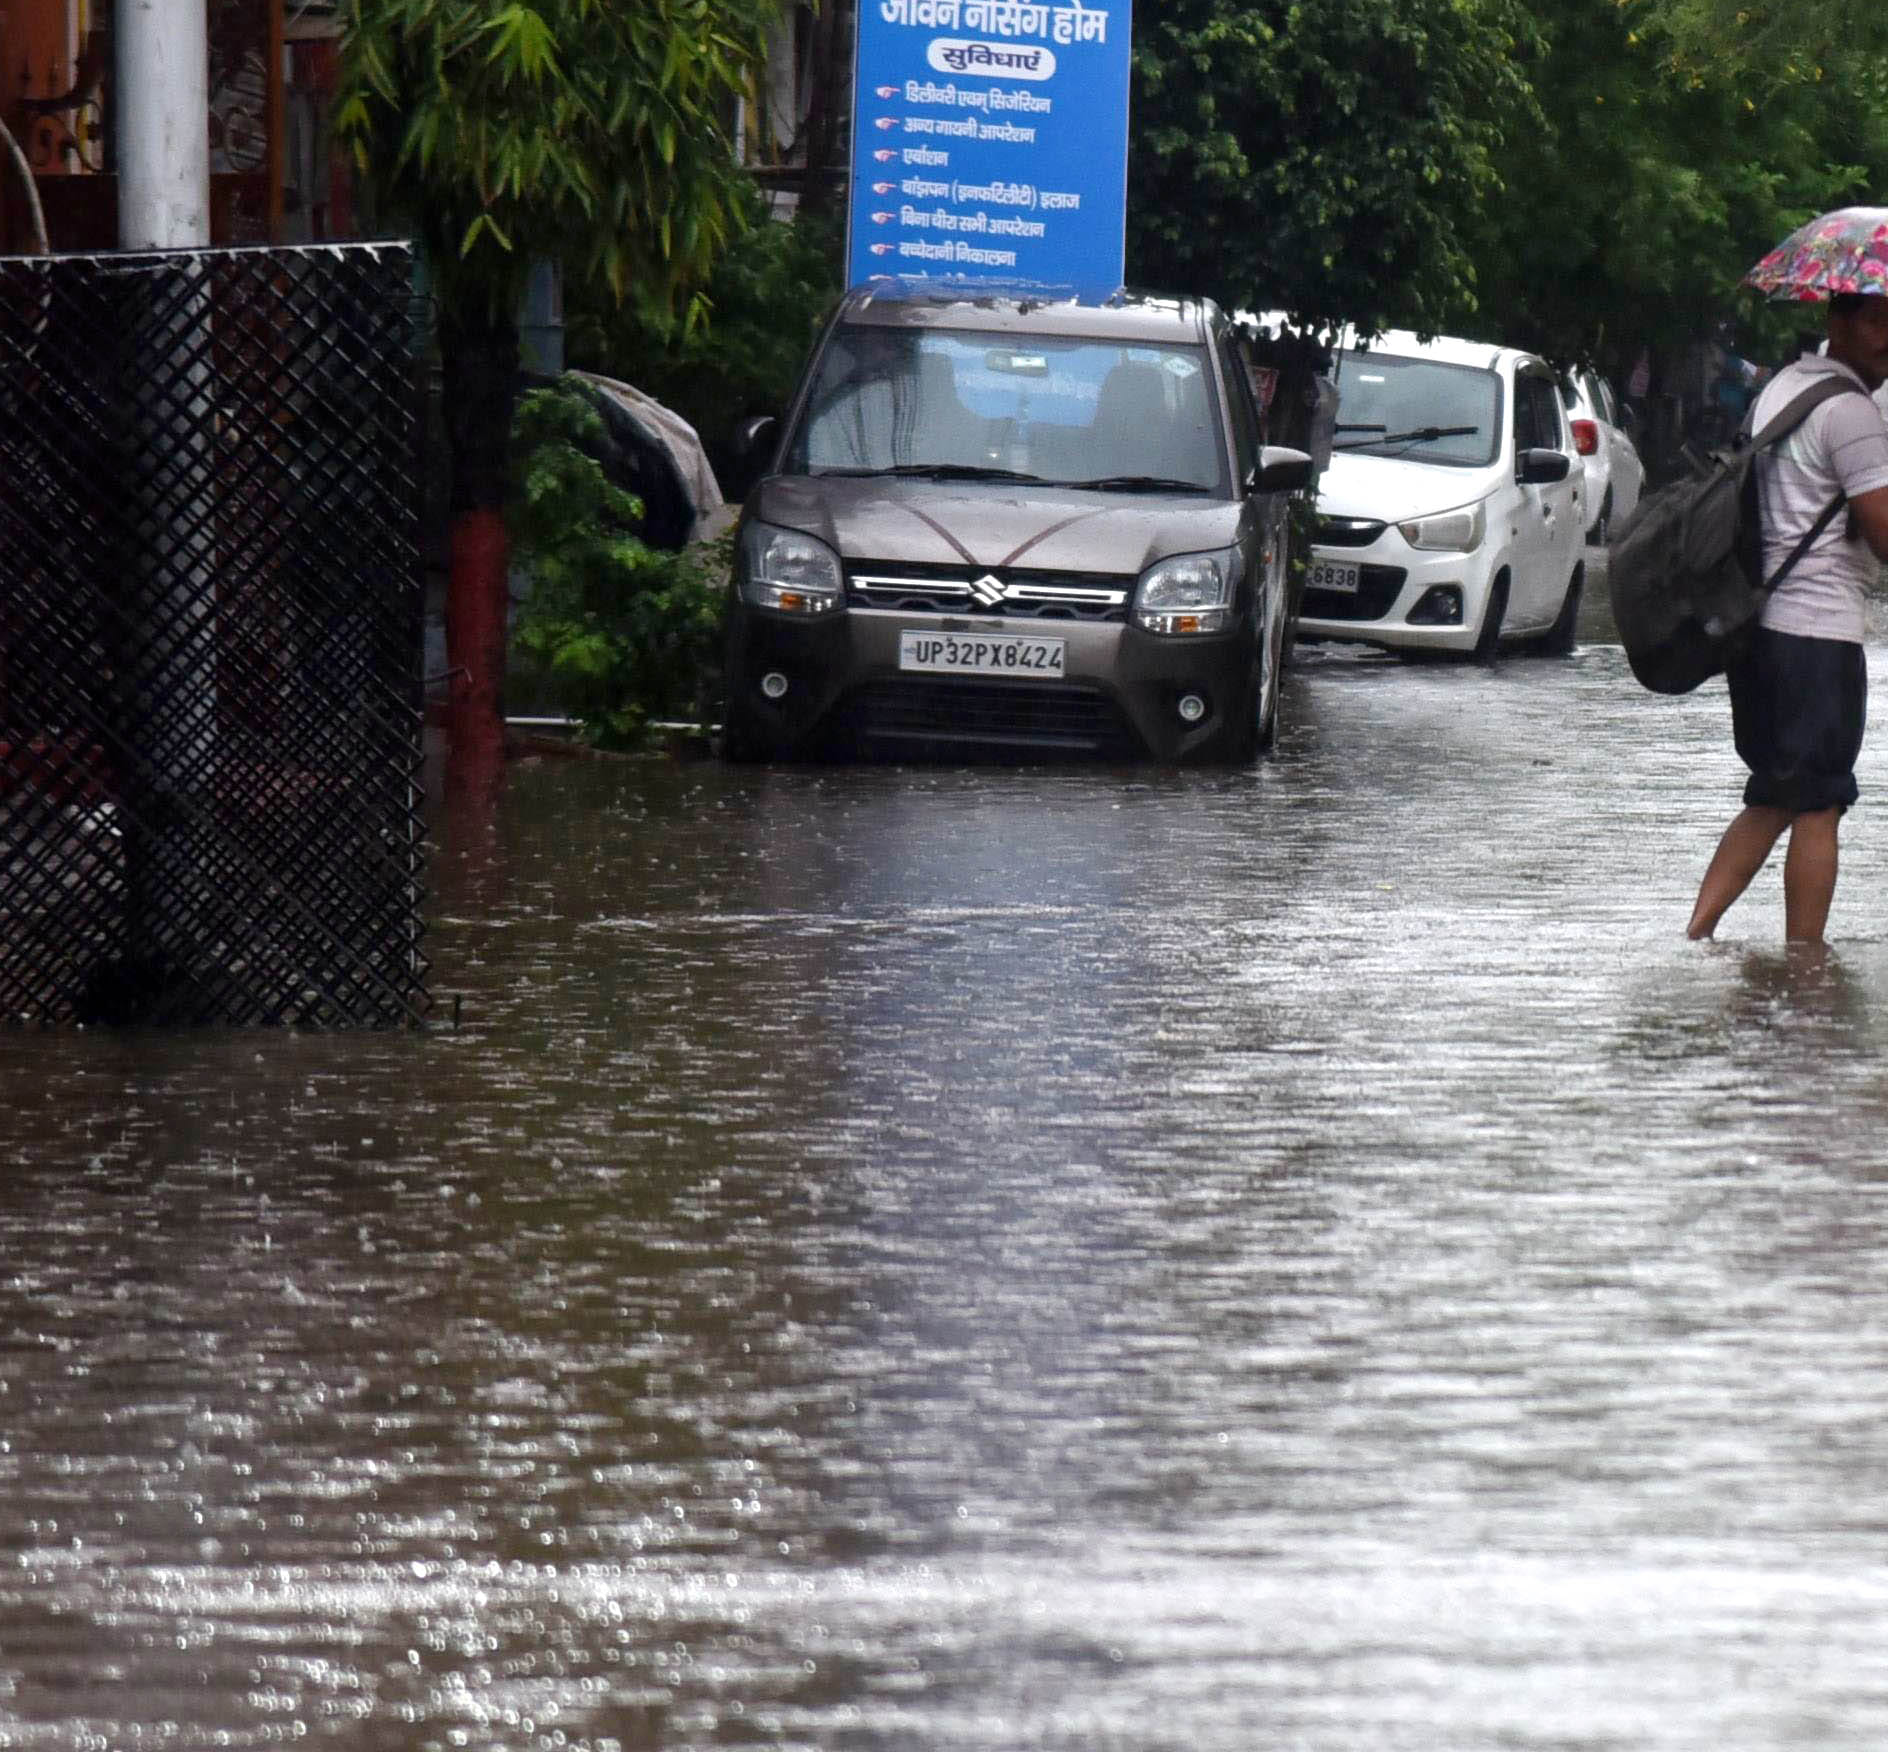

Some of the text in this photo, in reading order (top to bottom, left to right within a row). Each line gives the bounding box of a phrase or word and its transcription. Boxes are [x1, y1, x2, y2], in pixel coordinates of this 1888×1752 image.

[1052, 0, 1109, 44] होम
[941, 44, 1041, 71] सुविधाएं
[1039, 191, 1080, 209] इलाज
[1305, 566, 1356, 587] 6838
[916, 640, 1062, 669] UP32PX8424
